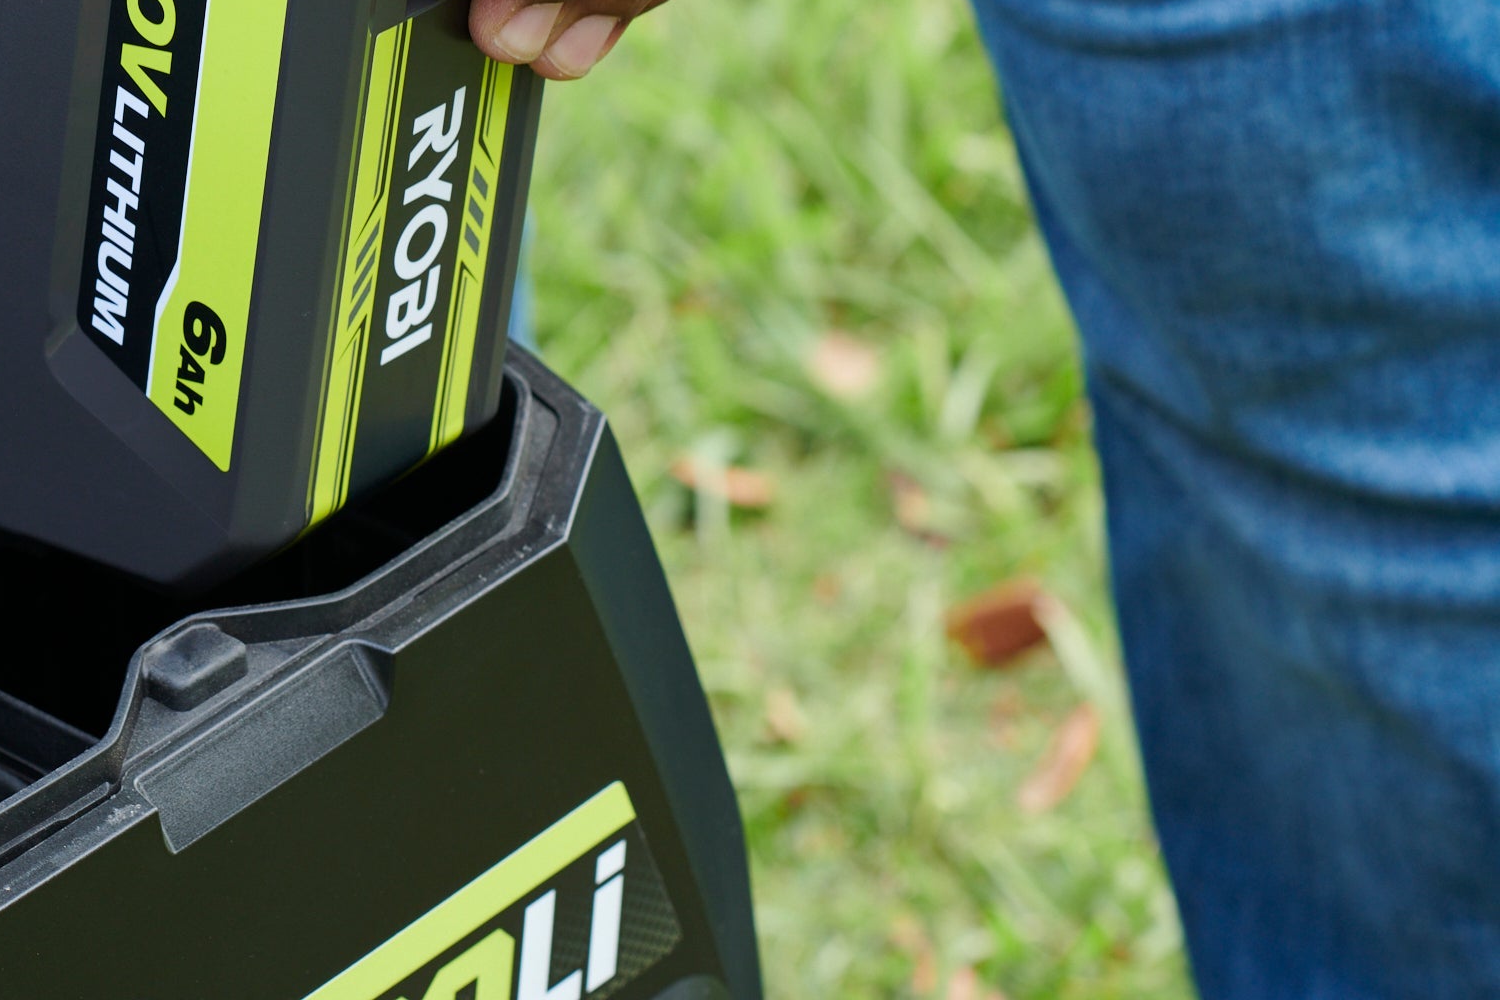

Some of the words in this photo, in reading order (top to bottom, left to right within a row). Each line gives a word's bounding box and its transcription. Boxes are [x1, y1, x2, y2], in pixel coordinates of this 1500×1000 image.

[91, 85, 149, 346] LITHIUM
[380, 85, 466, 366] RYOBI
[173, 300, 227, 417] 6Ah
